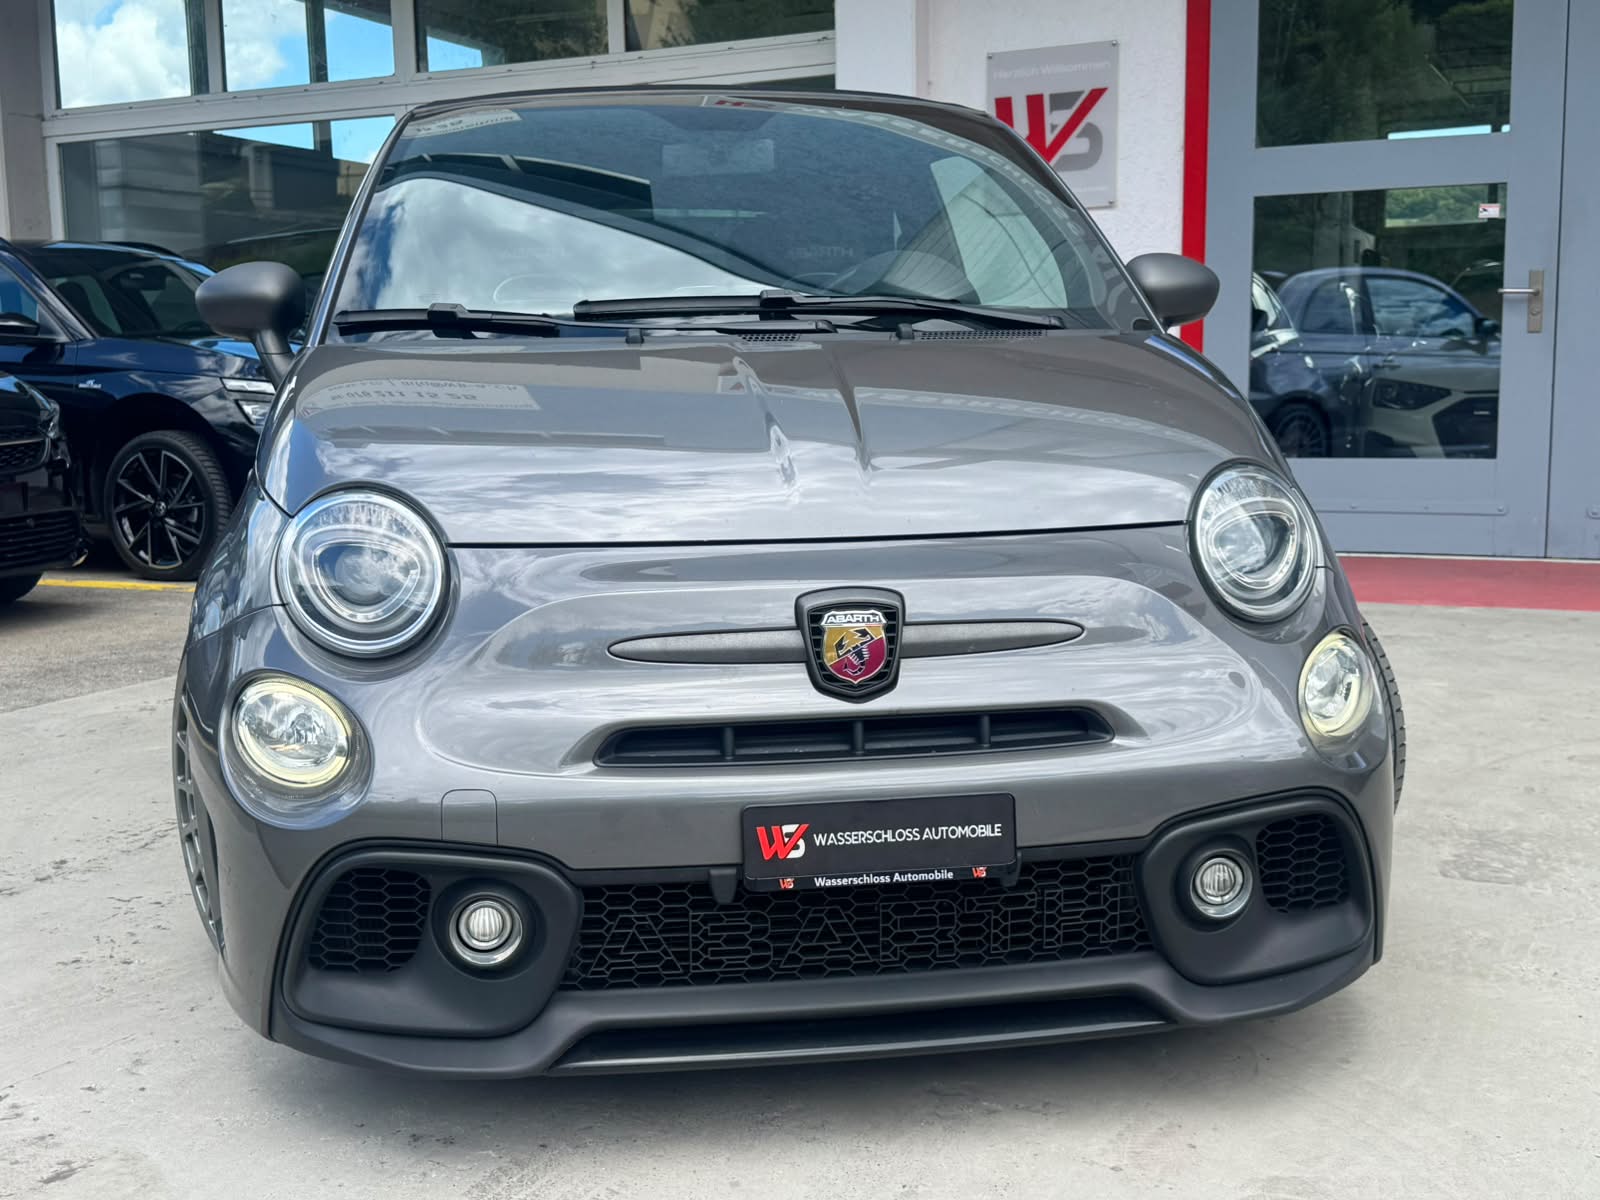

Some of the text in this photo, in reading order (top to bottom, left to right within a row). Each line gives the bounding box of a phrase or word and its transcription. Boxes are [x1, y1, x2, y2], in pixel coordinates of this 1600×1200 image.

[827, 614, 880, 624] ABARTH
[813, 823, 1002, 847] WASSERSCHLOSS AUTOMOBILE
[814, 872, 892, 888] Wasserschloss
[893, 869, 954, 883] Automobile
